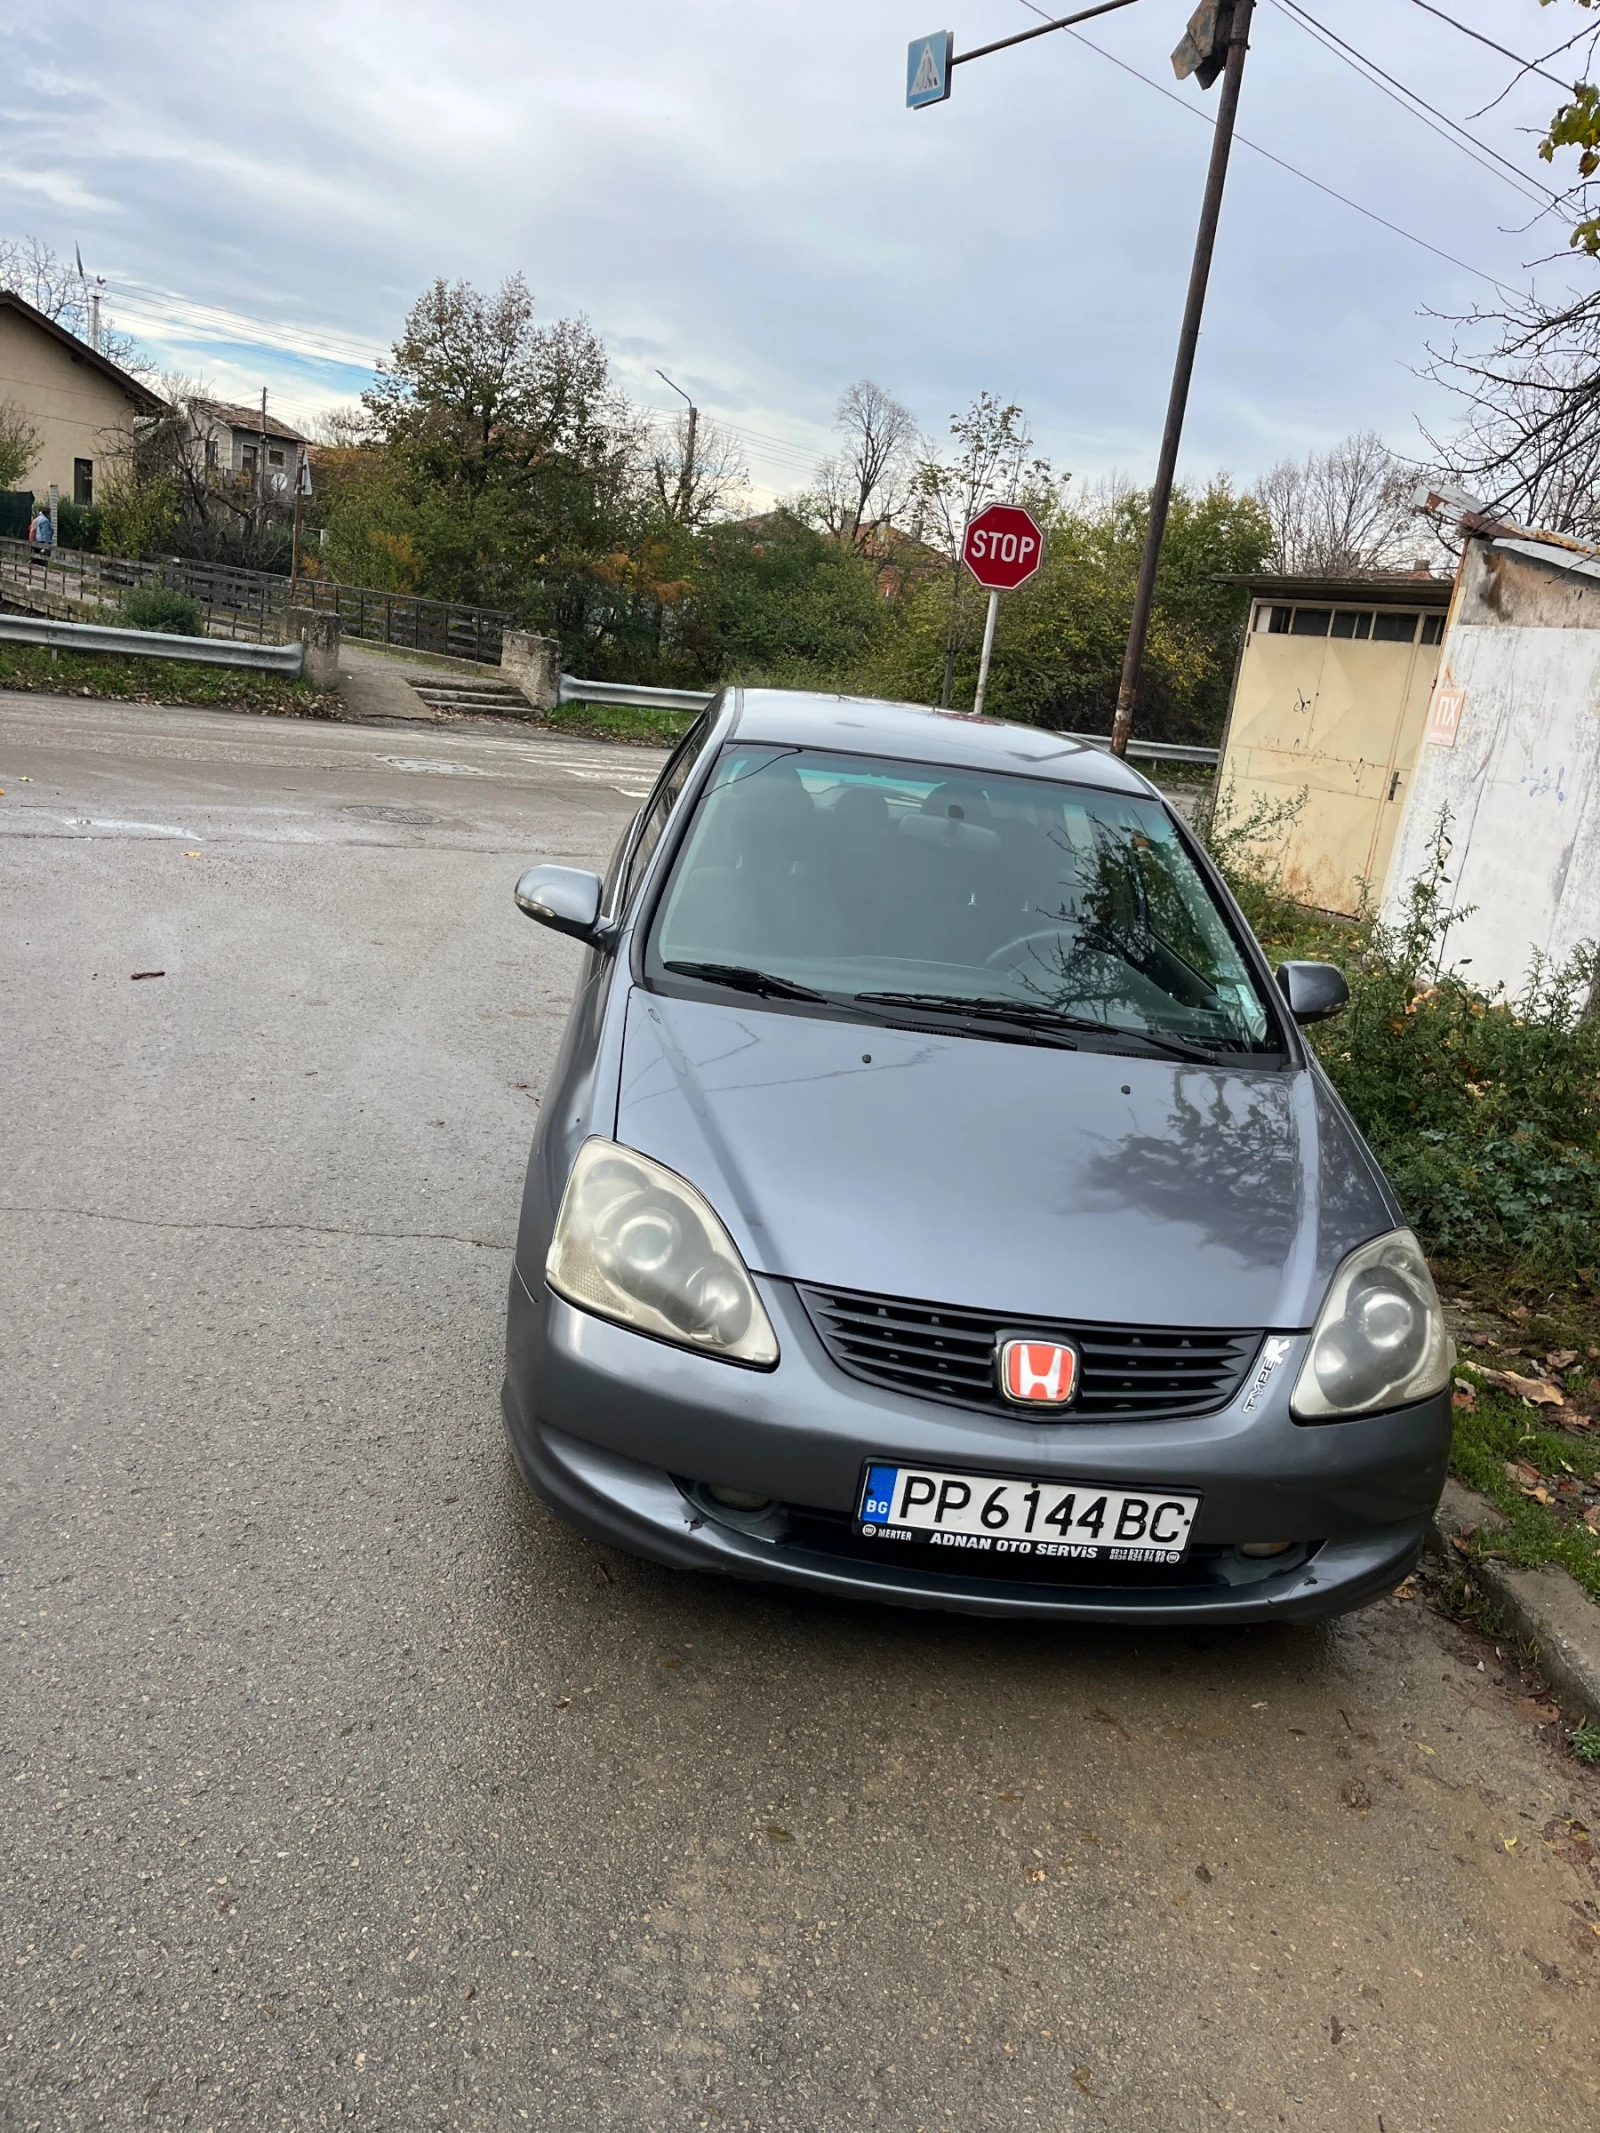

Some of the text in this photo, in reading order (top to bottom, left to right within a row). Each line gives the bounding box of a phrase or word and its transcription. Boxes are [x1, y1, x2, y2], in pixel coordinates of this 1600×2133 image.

[971, 529, 1035, 564] STOP
[866, 1499, 888, 1514] BG
[878, 1528, 912, 1541] MERTER
[929, 1532, 992, 1550] ADNAN
[995, 1539, 1032, 1554] OTO
